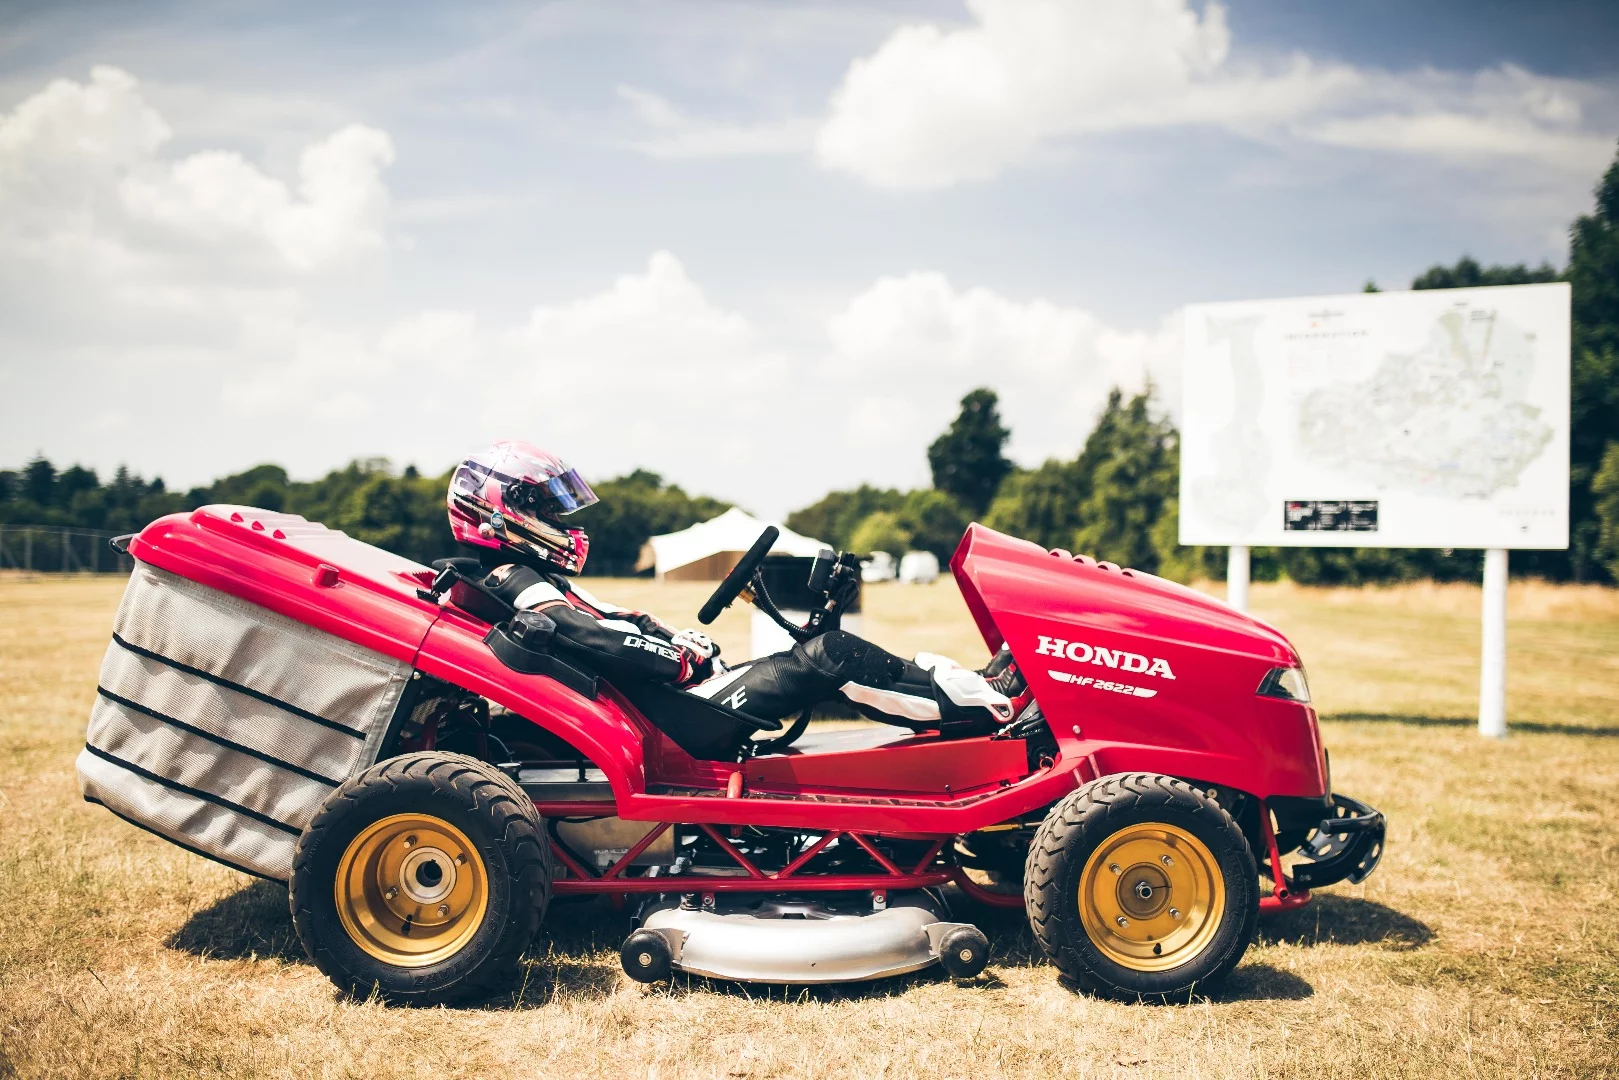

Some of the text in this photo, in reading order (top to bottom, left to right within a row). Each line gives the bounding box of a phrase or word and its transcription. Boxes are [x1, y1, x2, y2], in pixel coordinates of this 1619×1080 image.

[623, 635, 681, 662] DAINESE
[1035, 635, 1176, 680] HONDA
[1069, 675, 1135, 695] HF 2622
